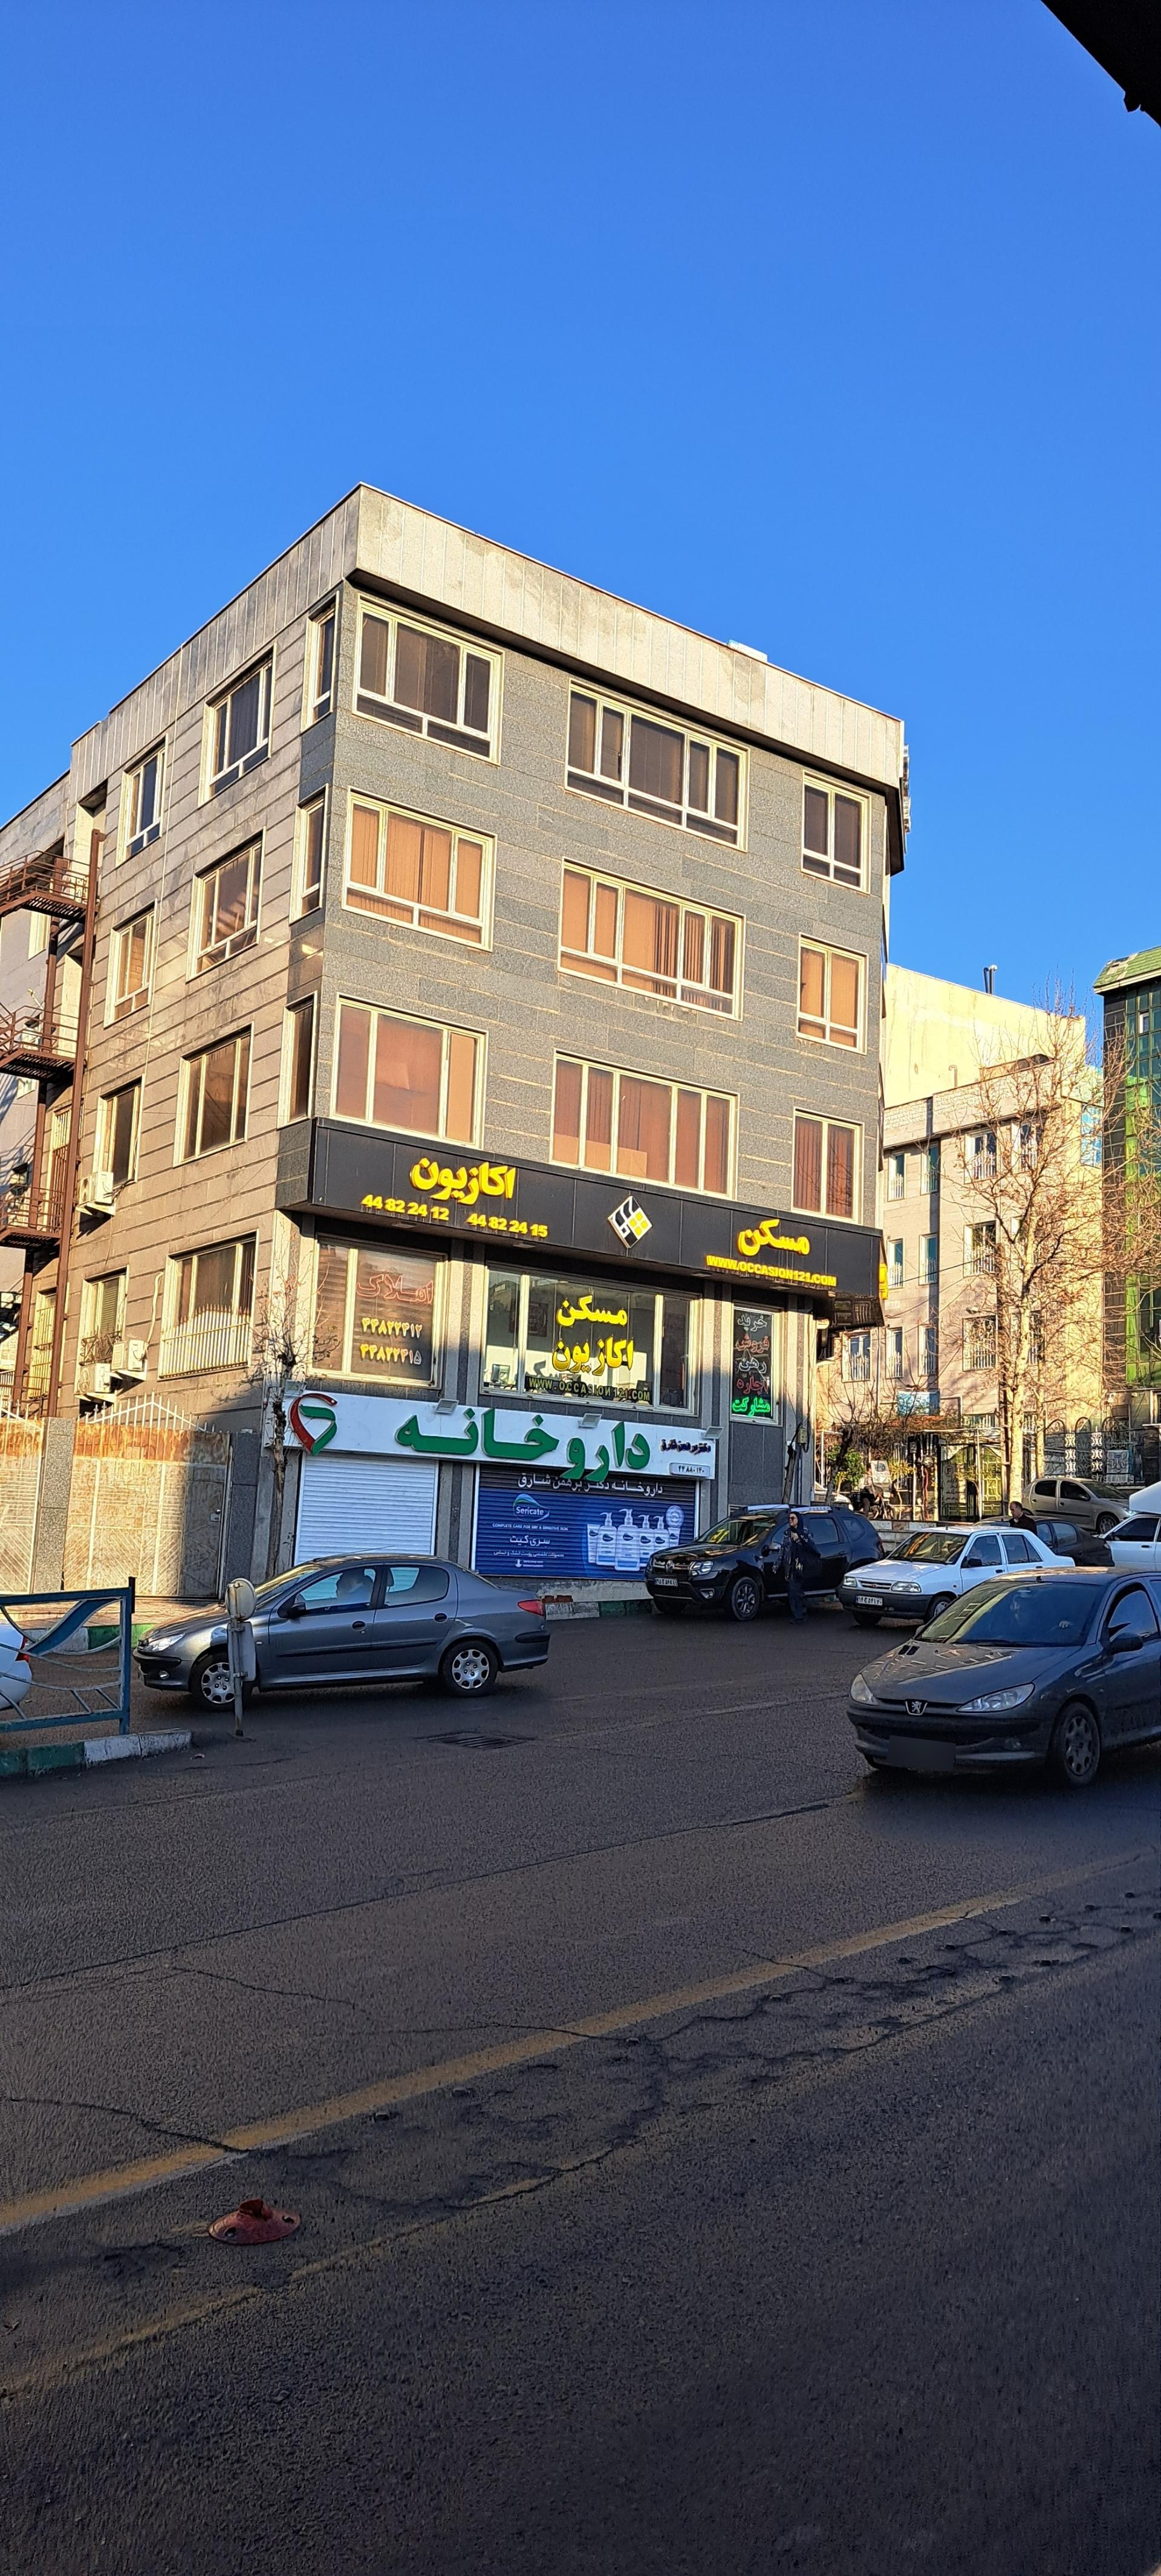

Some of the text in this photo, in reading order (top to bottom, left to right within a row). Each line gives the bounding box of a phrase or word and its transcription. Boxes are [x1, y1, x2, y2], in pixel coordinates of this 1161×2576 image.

[410, 1157, 516, 1205] اکازیون
[361, 1194, 449, 1221] 44 82 24 12
[466, 1213, 548, 1238] 44 82 24 15
[737, 1218, 811, 1257] مسکن
[706, 1255, 837, 1287] WWW.OCCASION121.COM
[356, 1273, 434, 1304] املاک
[556, 1295, 628, 1327] مسکن
[737, 1315, 767, 1332] خرید
[552, 1335, 634, 1376] اکازیون
[735, 1334, 770, 1353] فروش
[739, 1357, 767, 1373] رهن
[737, 1376, 769, 1394] اجاره
[732, 1397, 770, 1417] مشارکت
[395, 1408, 651, 1482] داروخانه
[518, 1472, 551, 1488] شارق
[611, 1480, 663, 1497] داروخانه
[516, 1506, 544, 1515] Sericate
